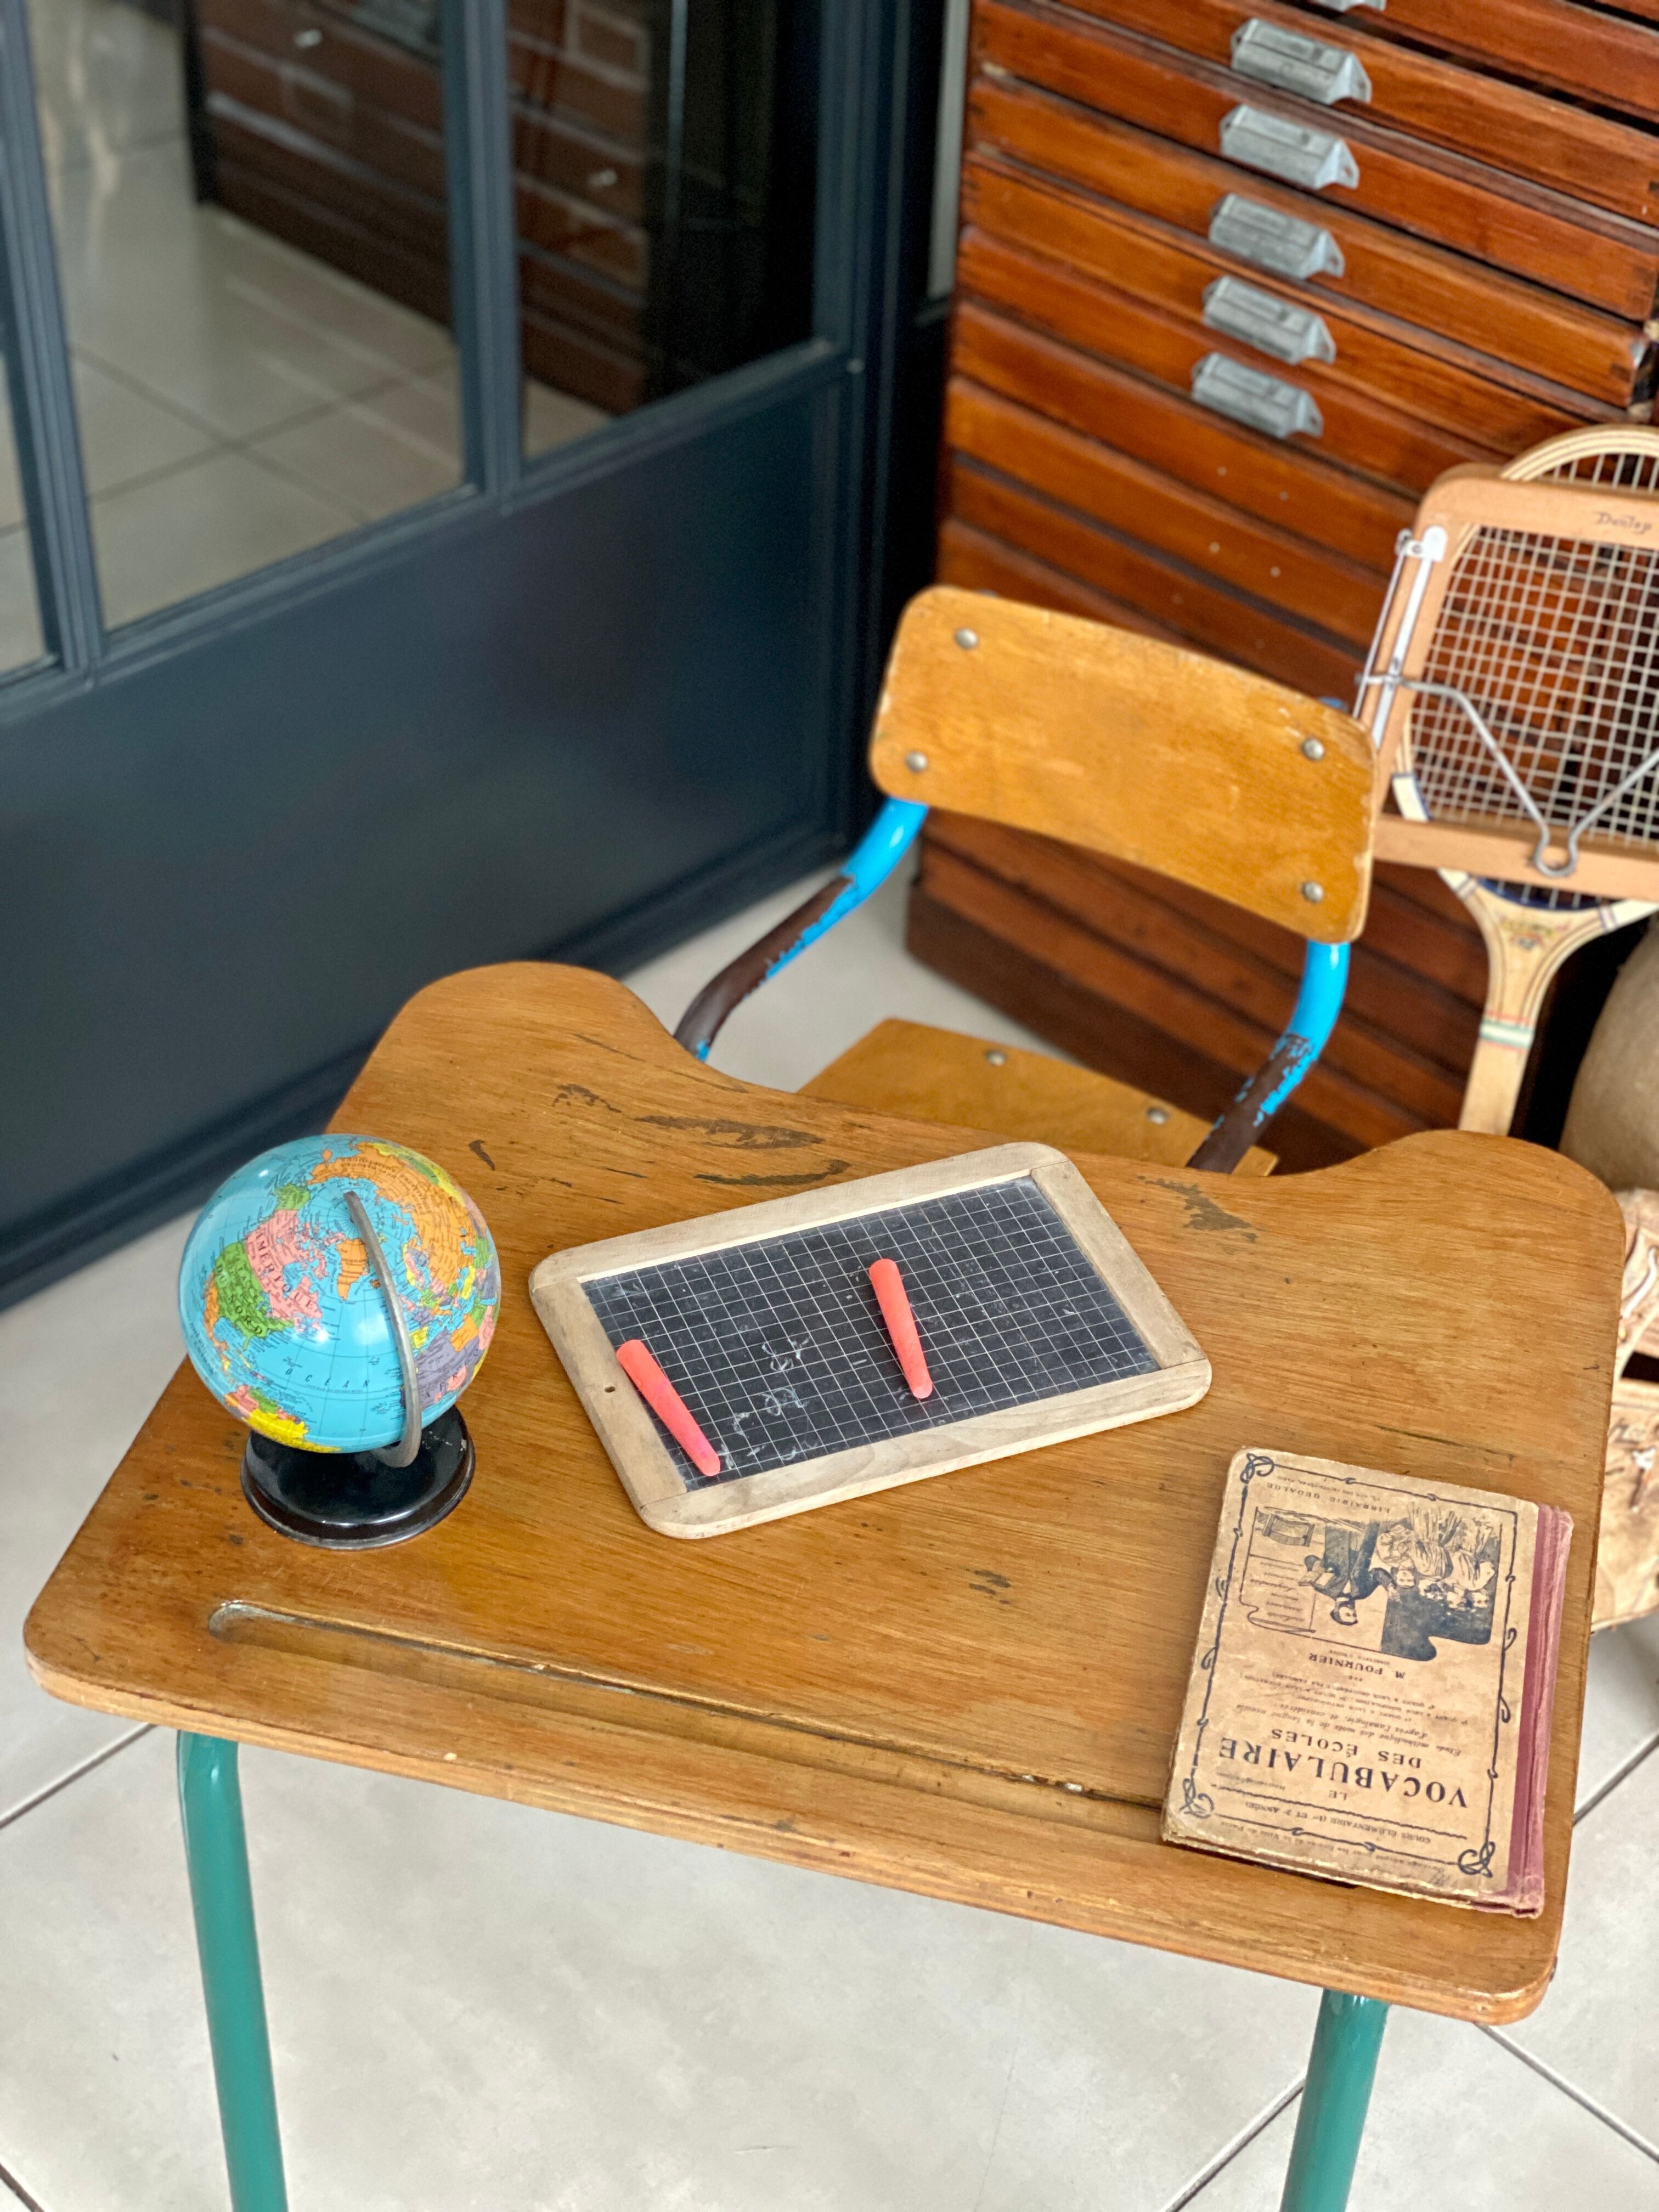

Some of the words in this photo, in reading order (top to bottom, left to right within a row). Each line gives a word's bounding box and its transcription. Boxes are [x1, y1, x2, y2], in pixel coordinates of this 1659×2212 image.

[1329, 1496, 1390, 1514] LIBRAIRIE
[1308, 1652, 1383, 1675] FOURNIER
[1306, 1718, 1314, 1726] la
[1319, 1721, 1330, 1729] de
[1269, 1728, 1358, 1758] ÉCOLES
[1359, 1729, 1374, 1739] des
[1378, 1731, 1429, 1750] méthodique
[1377, 1750, 1421, 1769] DES
[1218, 1737, 1469, 1807] VOCABULAIRE
[1328, 1790, 1347, 1801] LE
[1401, 1832, 1431, 1844] COURS
